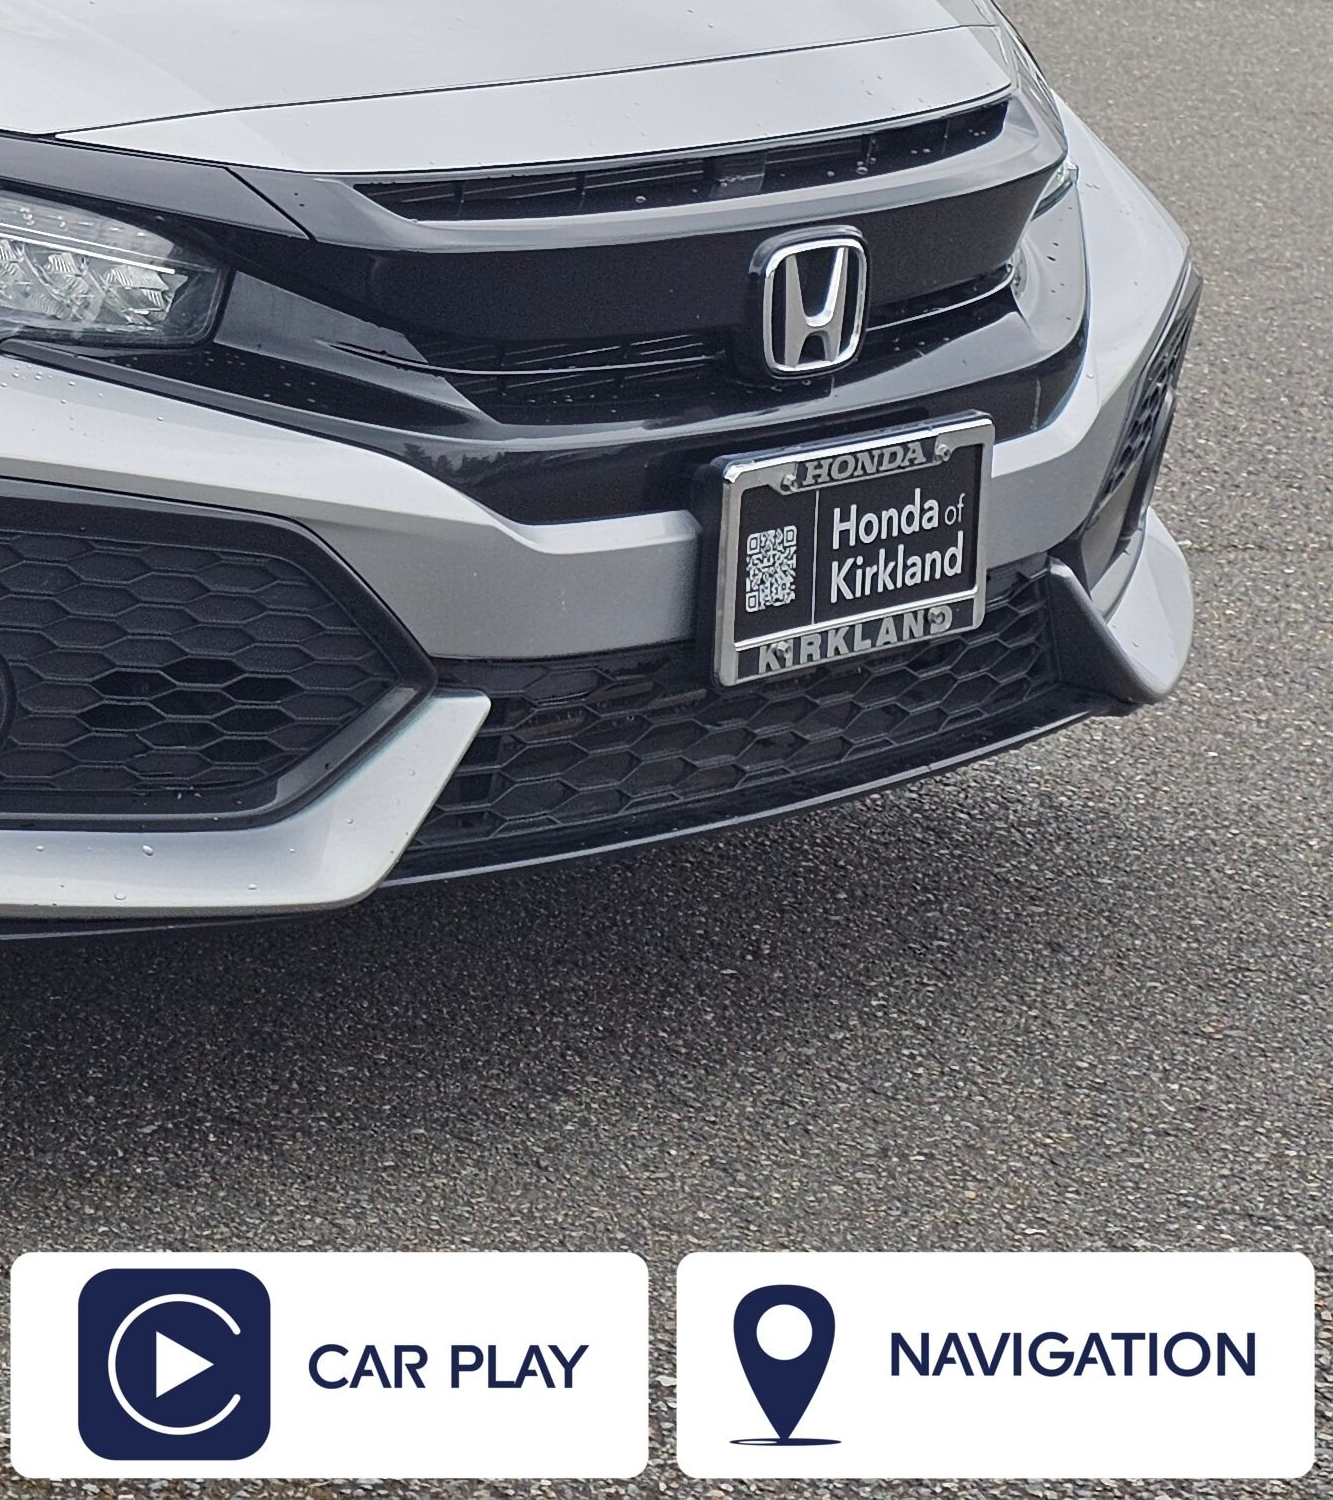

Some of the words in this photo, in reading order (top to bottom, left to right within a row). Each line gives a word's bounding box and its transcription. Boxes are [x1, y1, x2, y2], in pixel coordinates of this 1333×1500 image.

[803, 442, 927, 487] HONDA
[832, 488, 939, 550] Honda
[944, 493, 965, 526] of
[830, 530, 964, 604] Kirkland
[758, 605, 953, 674] KIRKLAND
